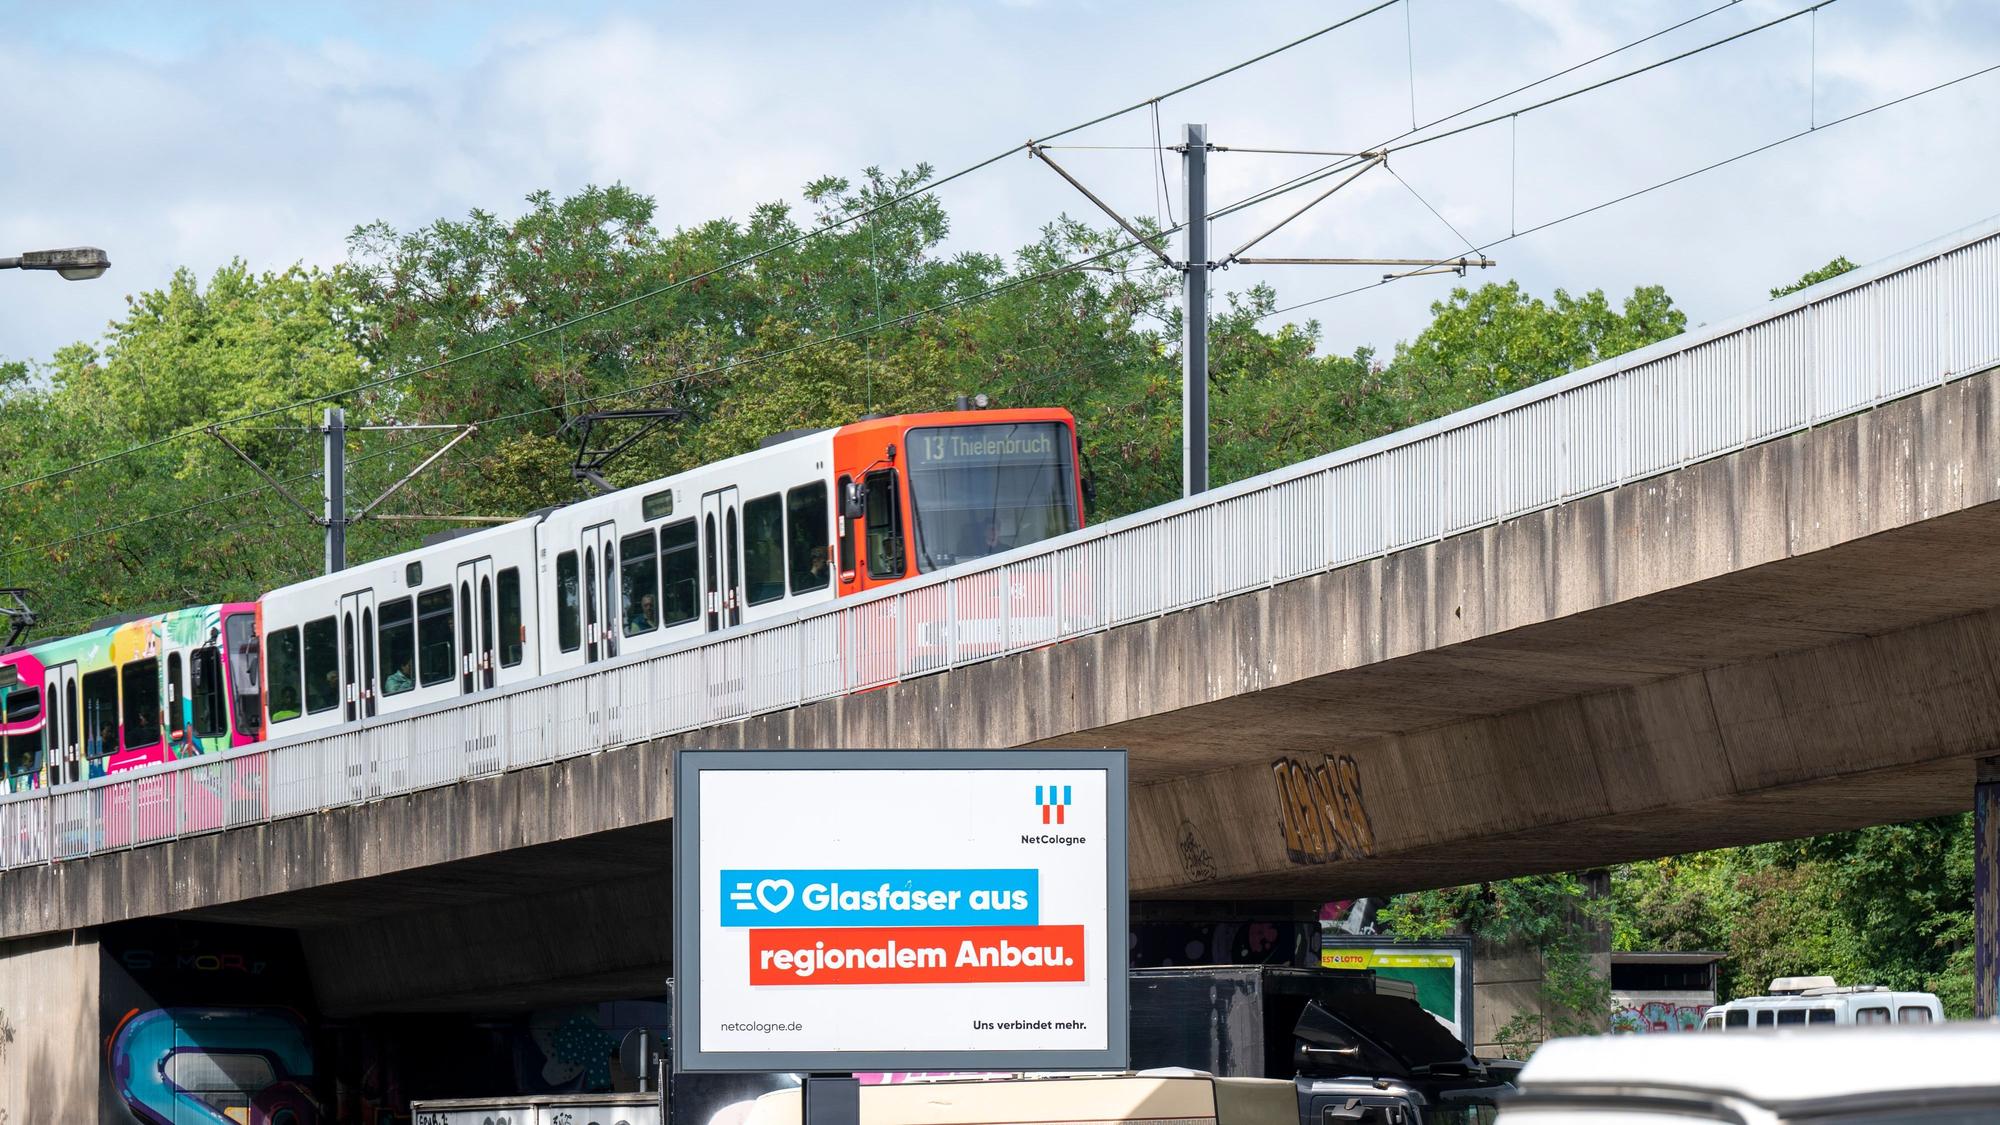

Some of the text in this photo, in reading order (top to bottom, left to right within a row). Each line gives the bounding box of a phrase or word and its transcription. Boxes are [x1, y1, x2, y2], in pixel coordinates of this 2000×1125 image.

[924, 433, 1050, 461] 13 Thielenbruch
[1021, 835, 1087, 846] NetCologne
[802, 883, 1028, 911] Glasfaser aus
[760, 940, 1073, 977] regionalem Anbau.
[721, 1021, 803, 1034] netcologne.de
[973, 1020, 1087, 1030] Uns verbindet mehr.
